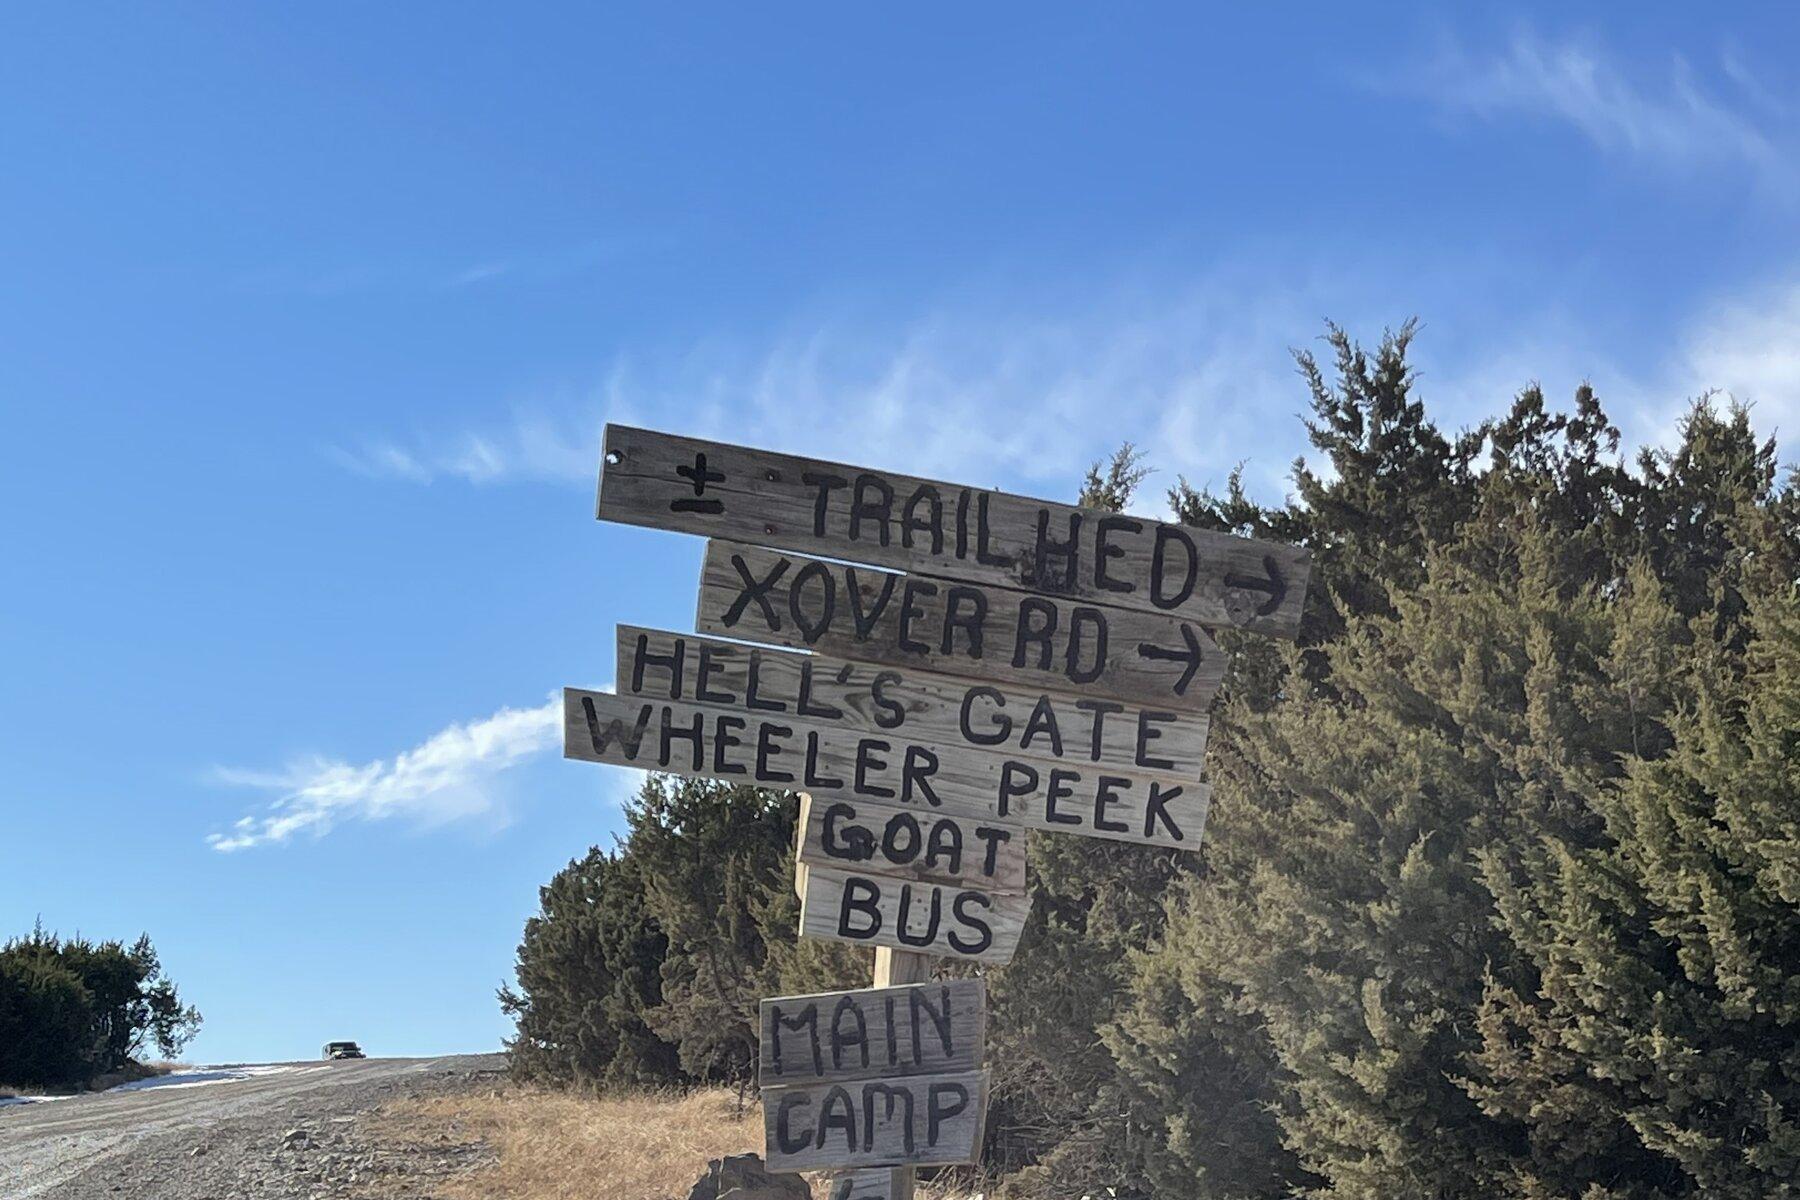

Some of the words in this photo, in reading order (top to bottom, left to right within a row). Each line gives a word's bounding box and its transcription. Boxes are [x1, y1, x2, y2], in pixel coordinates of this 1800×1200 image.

[1011, 598, 1108, 685] RD
[632, 633, 905, 728] HELL'S
[960, 686, 1177, 769] GATE
[581, 697, 942, 806] WHEELER
[998, 761, 1183, 841] PEEK
[822, 804, 1011, 876] GOAT
[838, 877, 992, 954] BUS
[771, 985, 954, 1076] MAIN
[777, 1082, 970, 1154] CAMP
